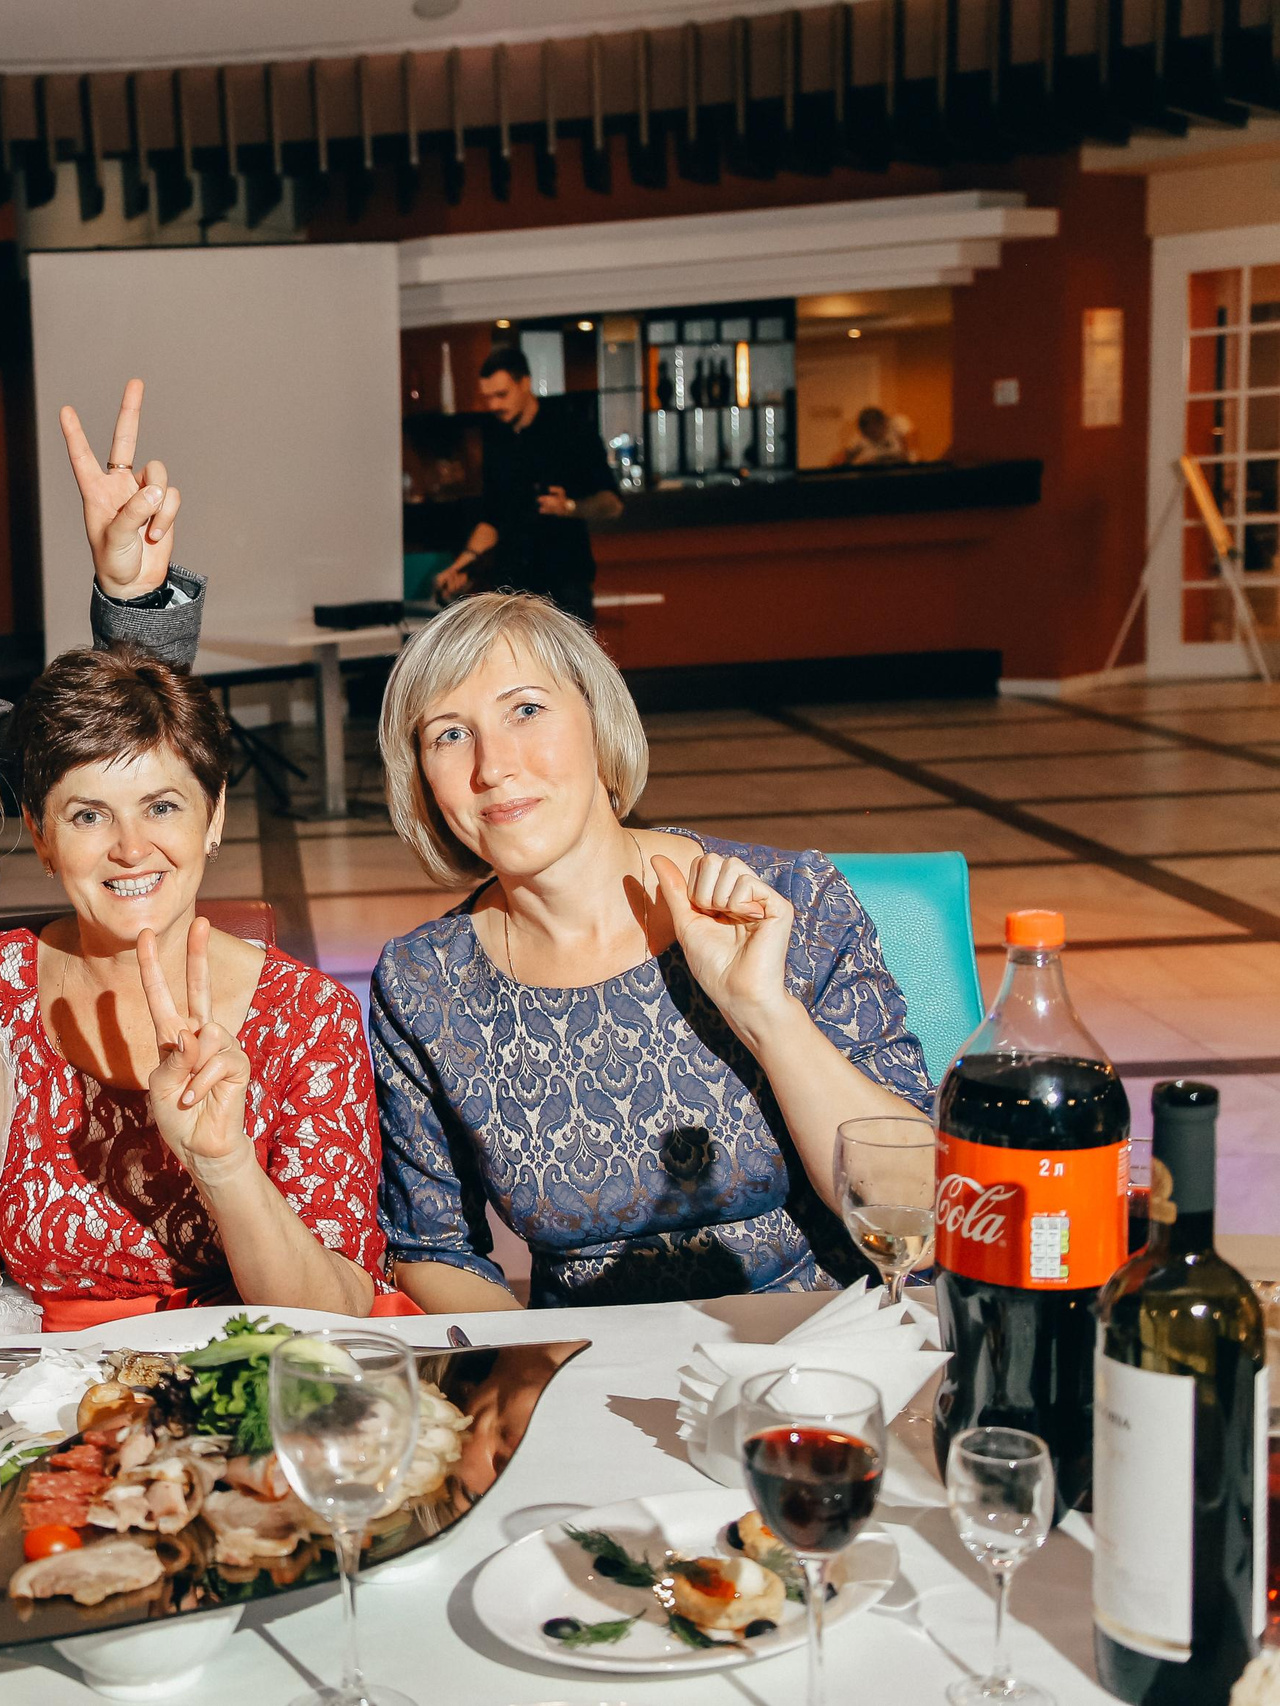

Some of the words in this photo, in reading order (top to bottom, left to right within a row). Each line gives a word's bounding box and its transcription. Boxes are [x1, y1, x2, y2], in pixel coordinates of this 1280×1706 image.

[1039, 1158, 1050, 1176] 2
[1053, 1162, 1064, 1177] л
[936, 1173, 1018, 1244] Cola
